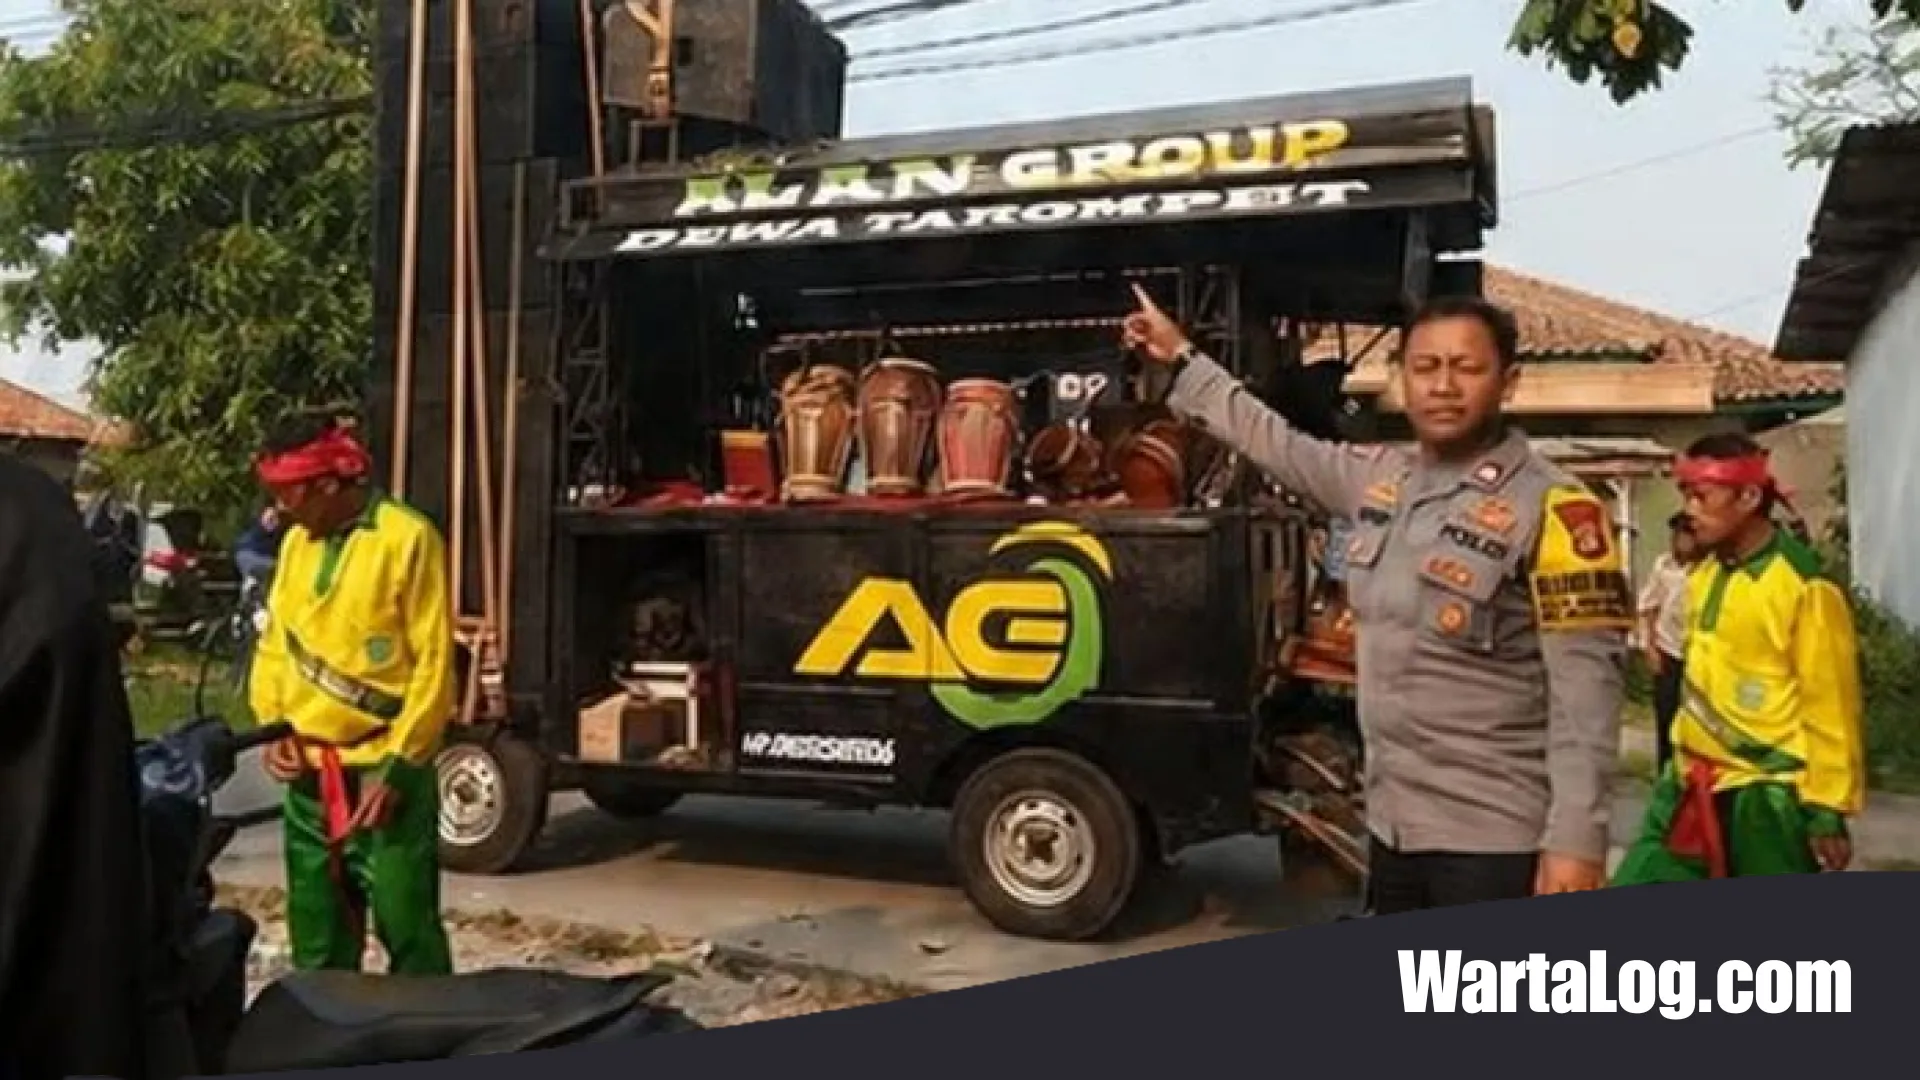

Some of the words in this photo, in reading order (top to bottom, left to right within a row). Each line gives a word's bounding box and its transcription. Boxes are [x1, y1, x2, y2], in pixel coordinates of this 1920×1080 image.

[674, 154, 976, 218] ALAN
[1002, 120, 1350, 188] GROUP
[614, 217, 841, 251] DEWA
[793, 578, 1068, 682] AG
